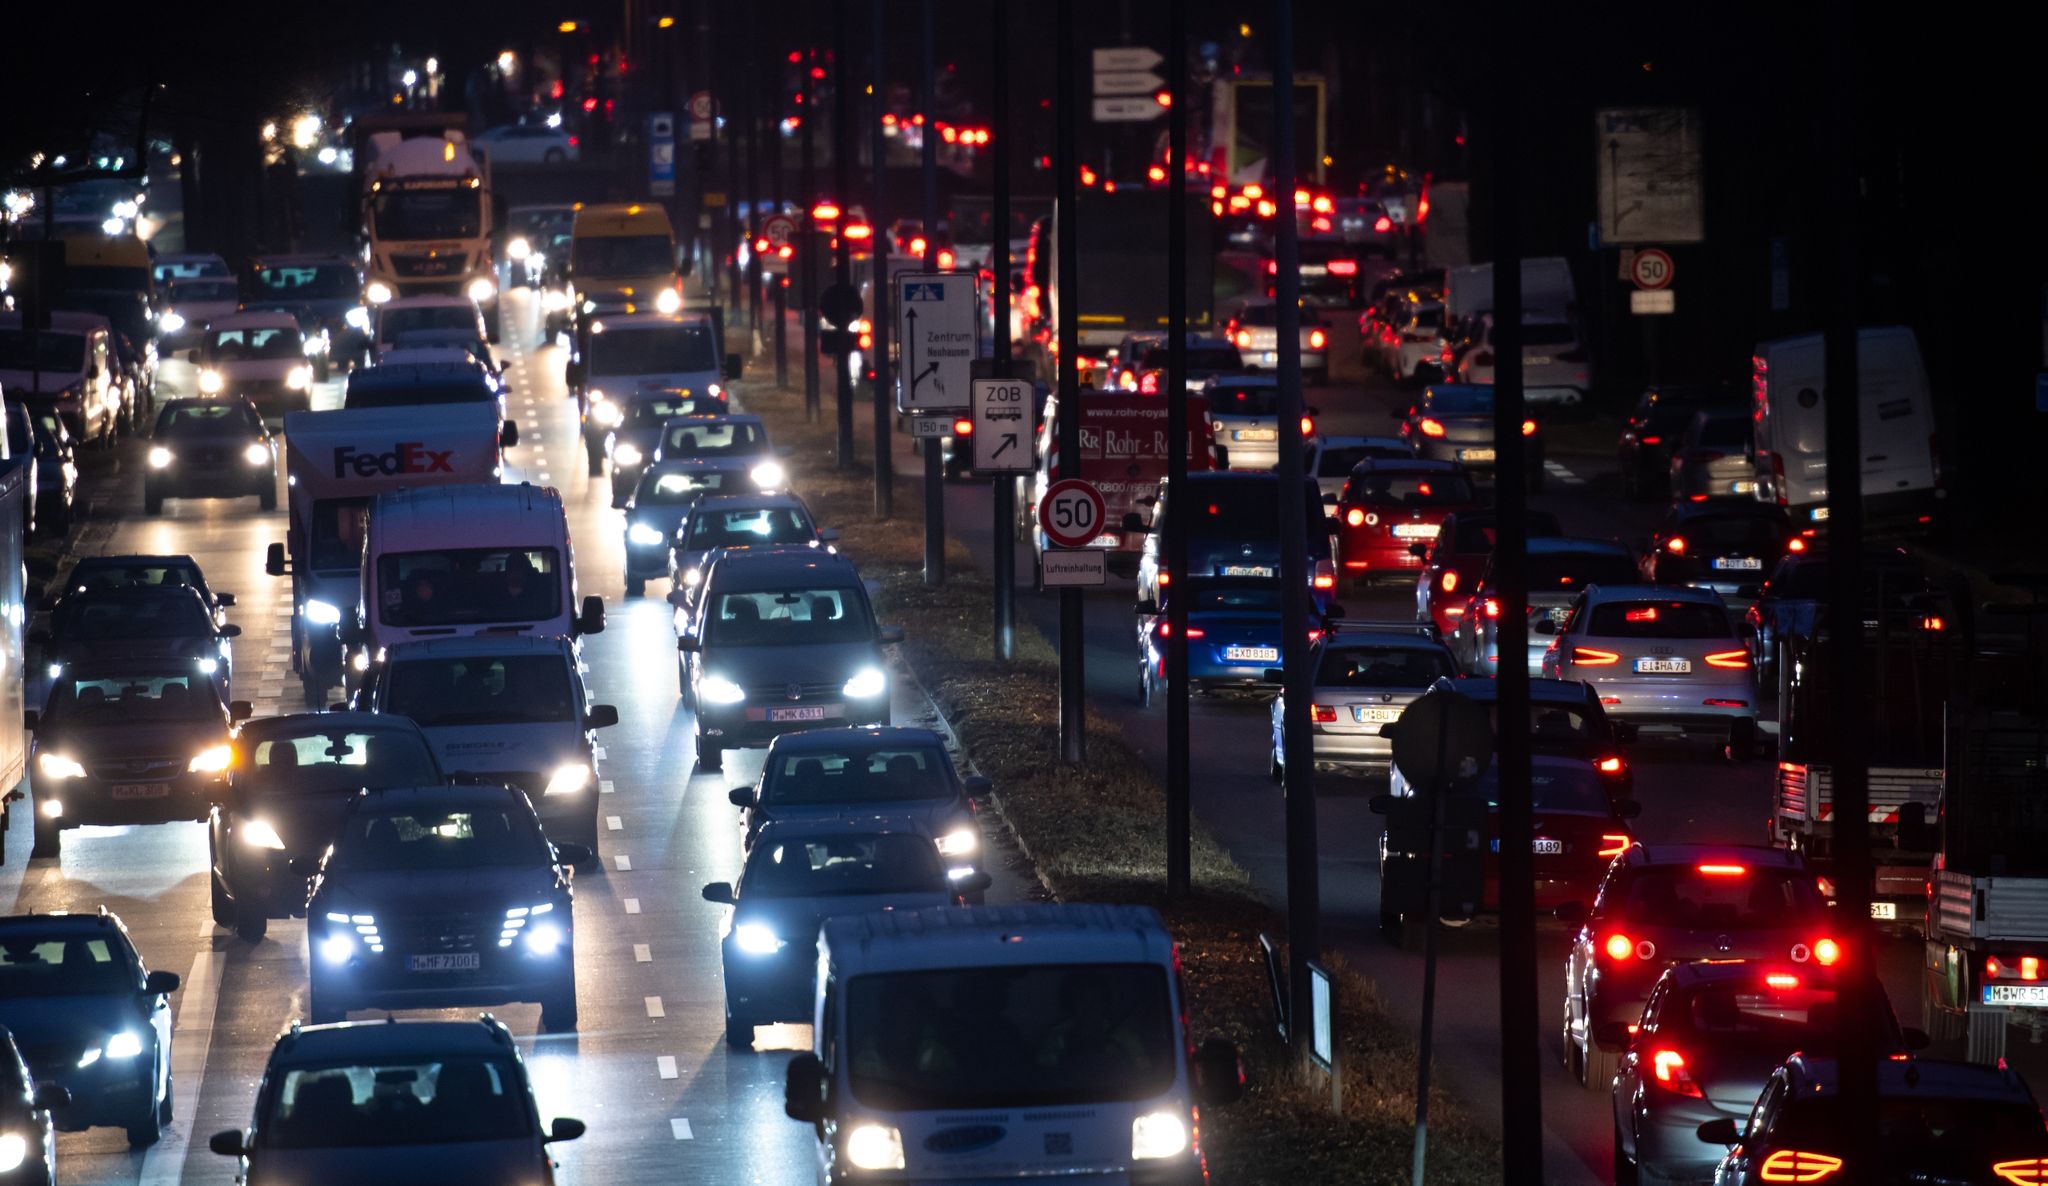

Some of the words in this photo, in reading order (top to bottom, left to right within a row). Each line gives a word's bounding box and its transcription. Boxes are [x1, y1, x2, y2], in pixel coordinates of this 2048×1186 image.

[1641, 261, 1662, 279] 50
[928, 332, 971, 342] Zentrum
[928, 348, 969, 357] Neuhausen
[986, 387, 1021, 401] ZOB
[1087, 408, 1168, 419] www.rohr-royal
[920, 422, 936, 432] 150
[1106, 430, 1140, 454] Rohr
[334, 442, 454, 479] FedEx
[1056, 499, 1091, 528] 50
[1046, 564, 1102, 574] Luftreinhaltung
[1538, 841, 1560, 853] 189
